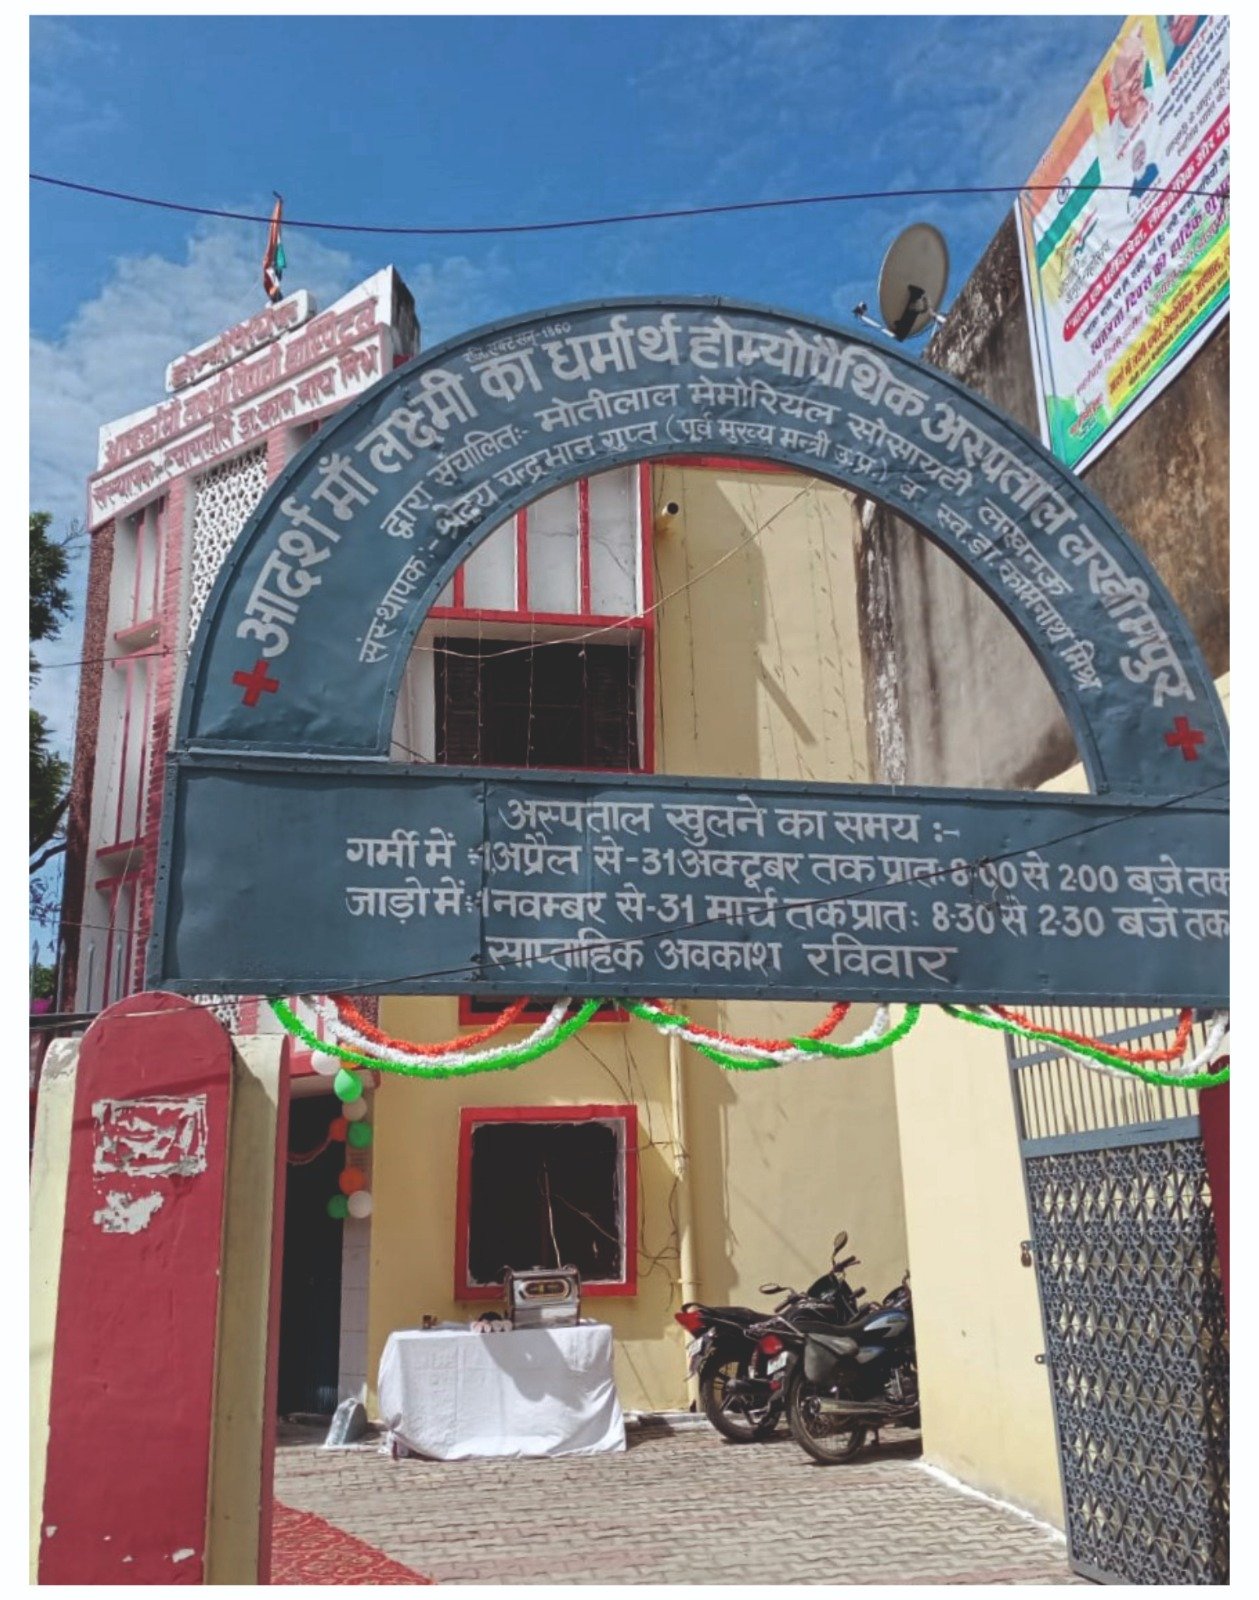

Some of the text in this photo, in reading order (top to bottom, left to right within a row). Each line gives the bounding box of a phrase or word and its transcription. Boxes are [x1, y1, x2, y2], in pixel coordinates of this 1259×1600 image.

[380, 480, 432, 539] द्वारा
[534, 383, 680, 432] मोतीलाल
[688, 375, 841, 425] मेमोरियल
[848, 413, 973, 497] सोसायटी
[236, 496, 341, 658] आदर्श
[355, 368, 478, 473] लक्ष्मी
[470, 347, 543, 402] का
[542, 314, 683, 381] धर्मार्थ
[688, 316, 930, 417] होम्योपैथिक
[921, 402, 1078, 534] अस्पताल
[1058, 523, 1196, 707] लखीमपुर
[599, 421, 658, 454] गुप्त
[718, 419, 776, 446] मुख्य
[1060, 639, 1102, 692] मिश्र
[499, 798, 654, 835] अस्पताल
[662, 794, 767, 848] खुलने
[774, 809, 827, 843] का
[834, 812, 920, 844] समय
[346, 828, 419, 868] गर्मी
[424, 827, 457, 869] में
[808, 854, 876, 885] तक
[1020, 850, 1050, 892] से
[1124, 853, 1182, 897] बजे
[433, 876, 465, 918] में
[490, 889, 607, 924] नवम्बर
[704, 886, 778, 928] मार्च
[783, 898, 846, 930] तक
[1000, 893, 1028, 937] से
[1112, 898, 1179, 939] बजे
[484, 927, 959, 982] साप्ताहिक अवकाश रविवार
